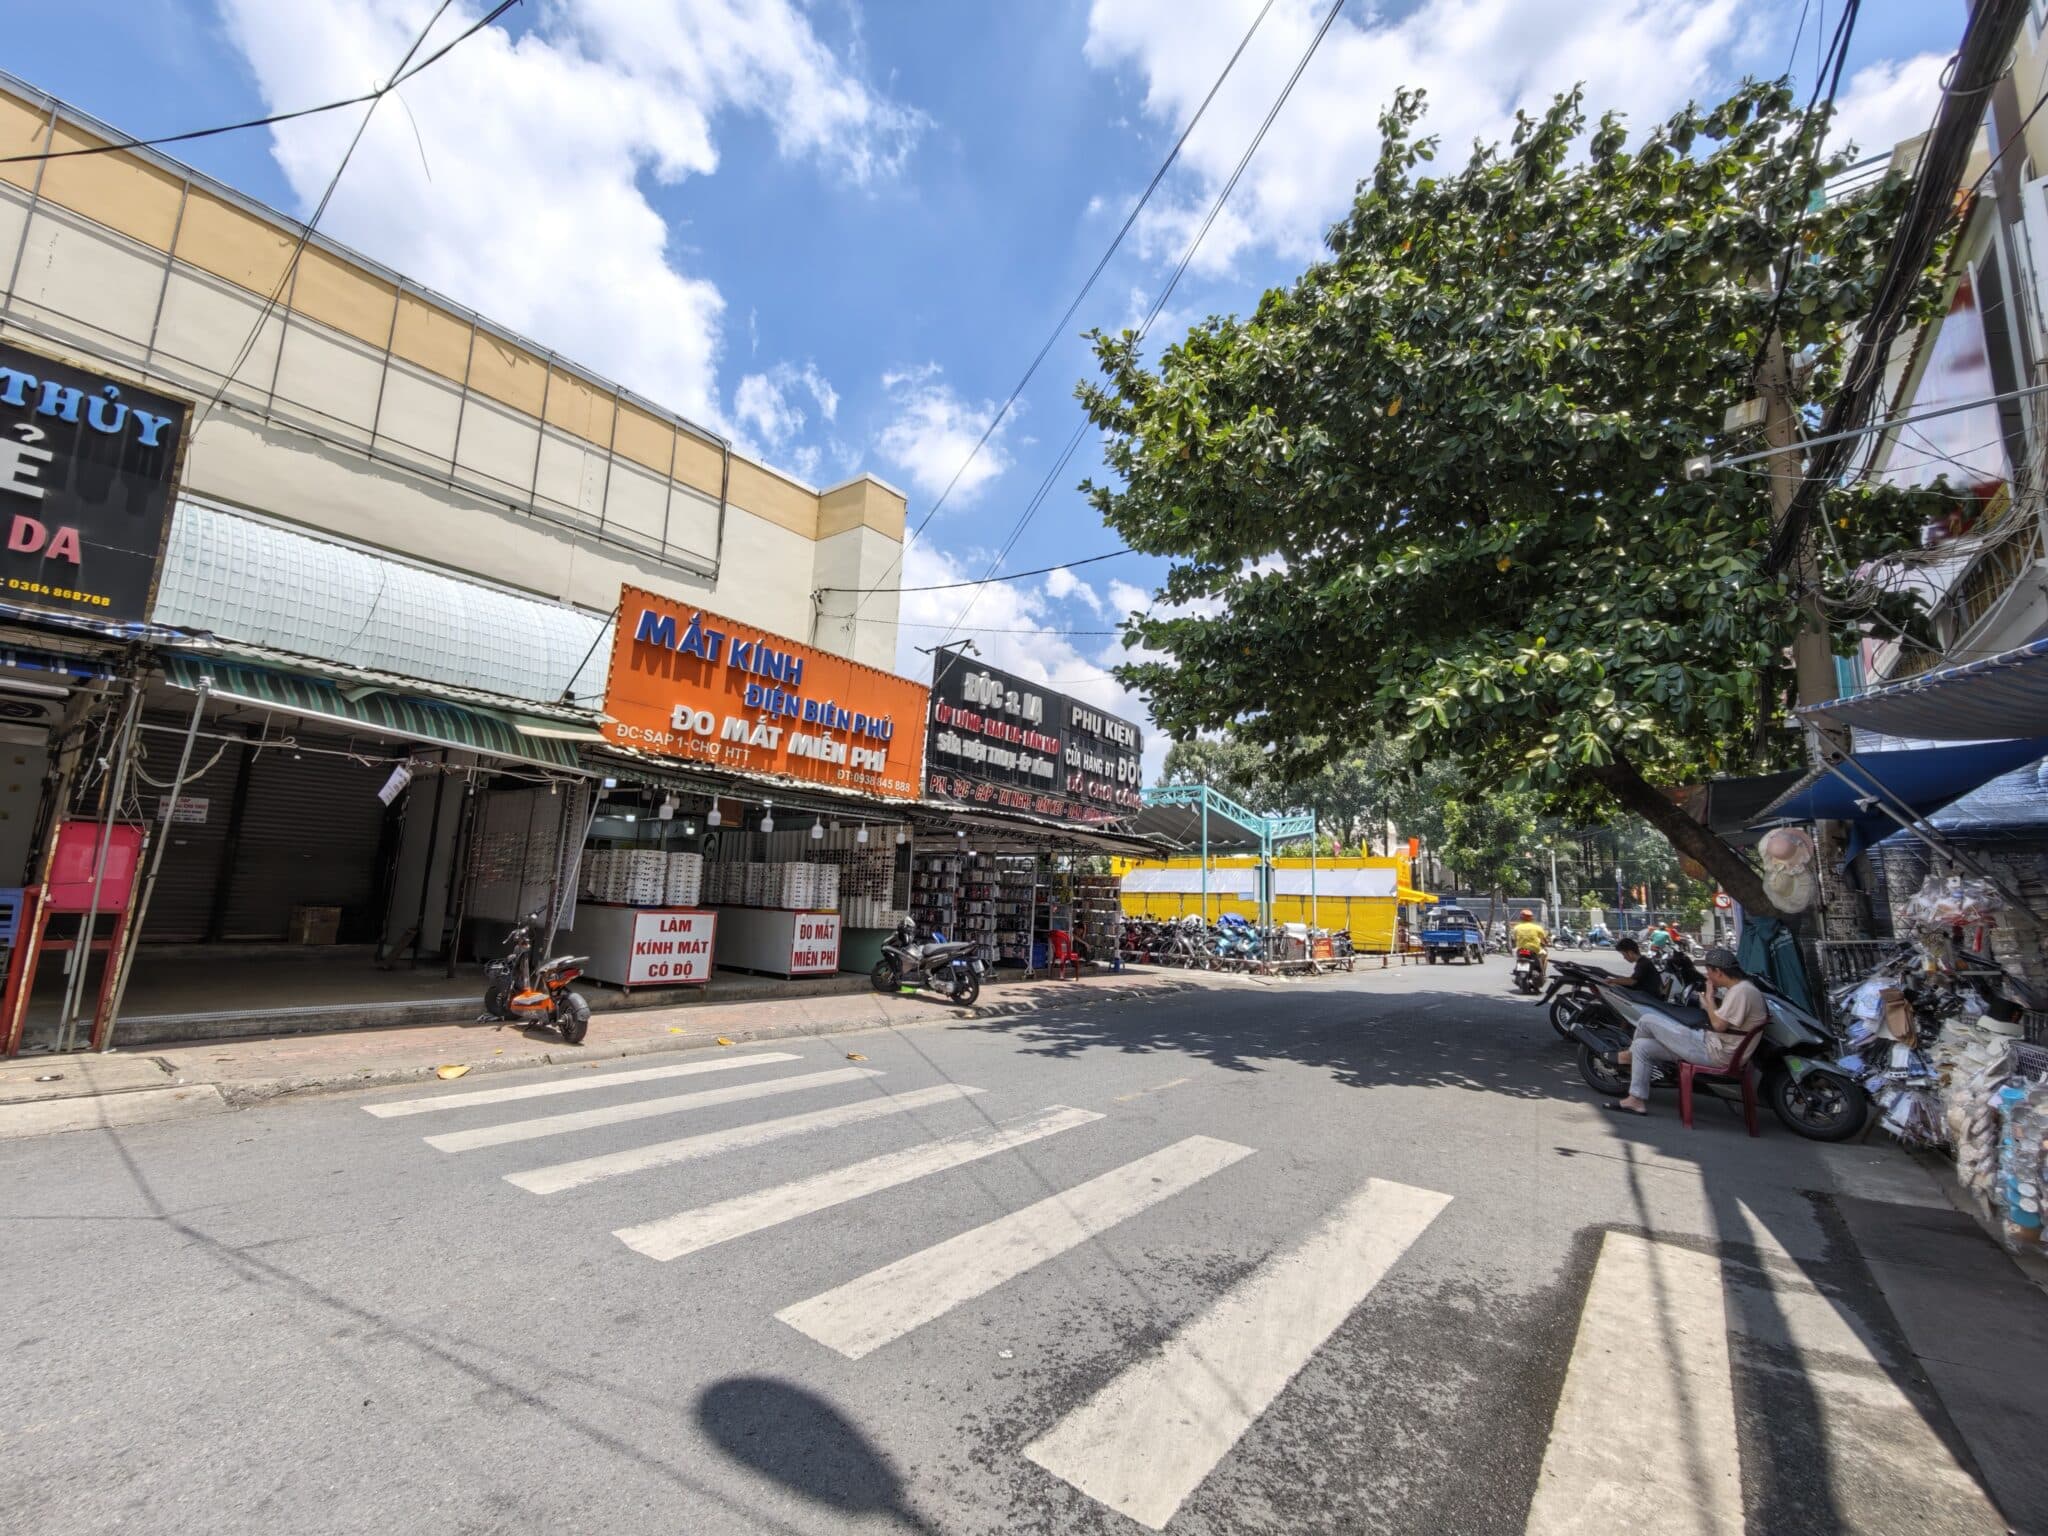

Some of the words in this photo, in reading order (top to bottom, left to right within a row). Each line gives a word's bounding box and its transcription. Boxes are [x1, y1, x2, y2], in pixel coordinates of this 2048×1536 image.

[8, 514, 81, 564] DA
[635, 609, 725, 663] MẮT
[727, 639, 803, 687] KÍNH
[744, 683, 801, 720] ĐIỆN
[803, 698, 851, 733] BIÊN
[852, 713, 894, 742] PHỦ
[1071, 706, 1102, 738] PHỤ
[1105, 720, 1135, 747] KIỆN
[671, 703, 716, 736] ĐO
[721, 714, 784, 750] MẮT
[788, 731, 847, 765] MIỄN
[851, 746, 887, 773] PHÍ
[725, 747, 751, 762] HTT
[1083, 750, 1104, 775] HÀNG
[1104, 761, 1115, 778] ĐT
[929, 774, 947, 794] PIN
[659, 916, 692, 933] LÀM
[800, 924, 812, 940] ĐO
[815, 918, 835, 940] MẮT
[636, 939, 673, 955] KÍNH
[793, 946, 818, 967] MIỄN
[820, 946, 837, 966] PHÍ
[648, 961, 668, 977] CÓ
[673, 960, 693, 979] ĐỘ
